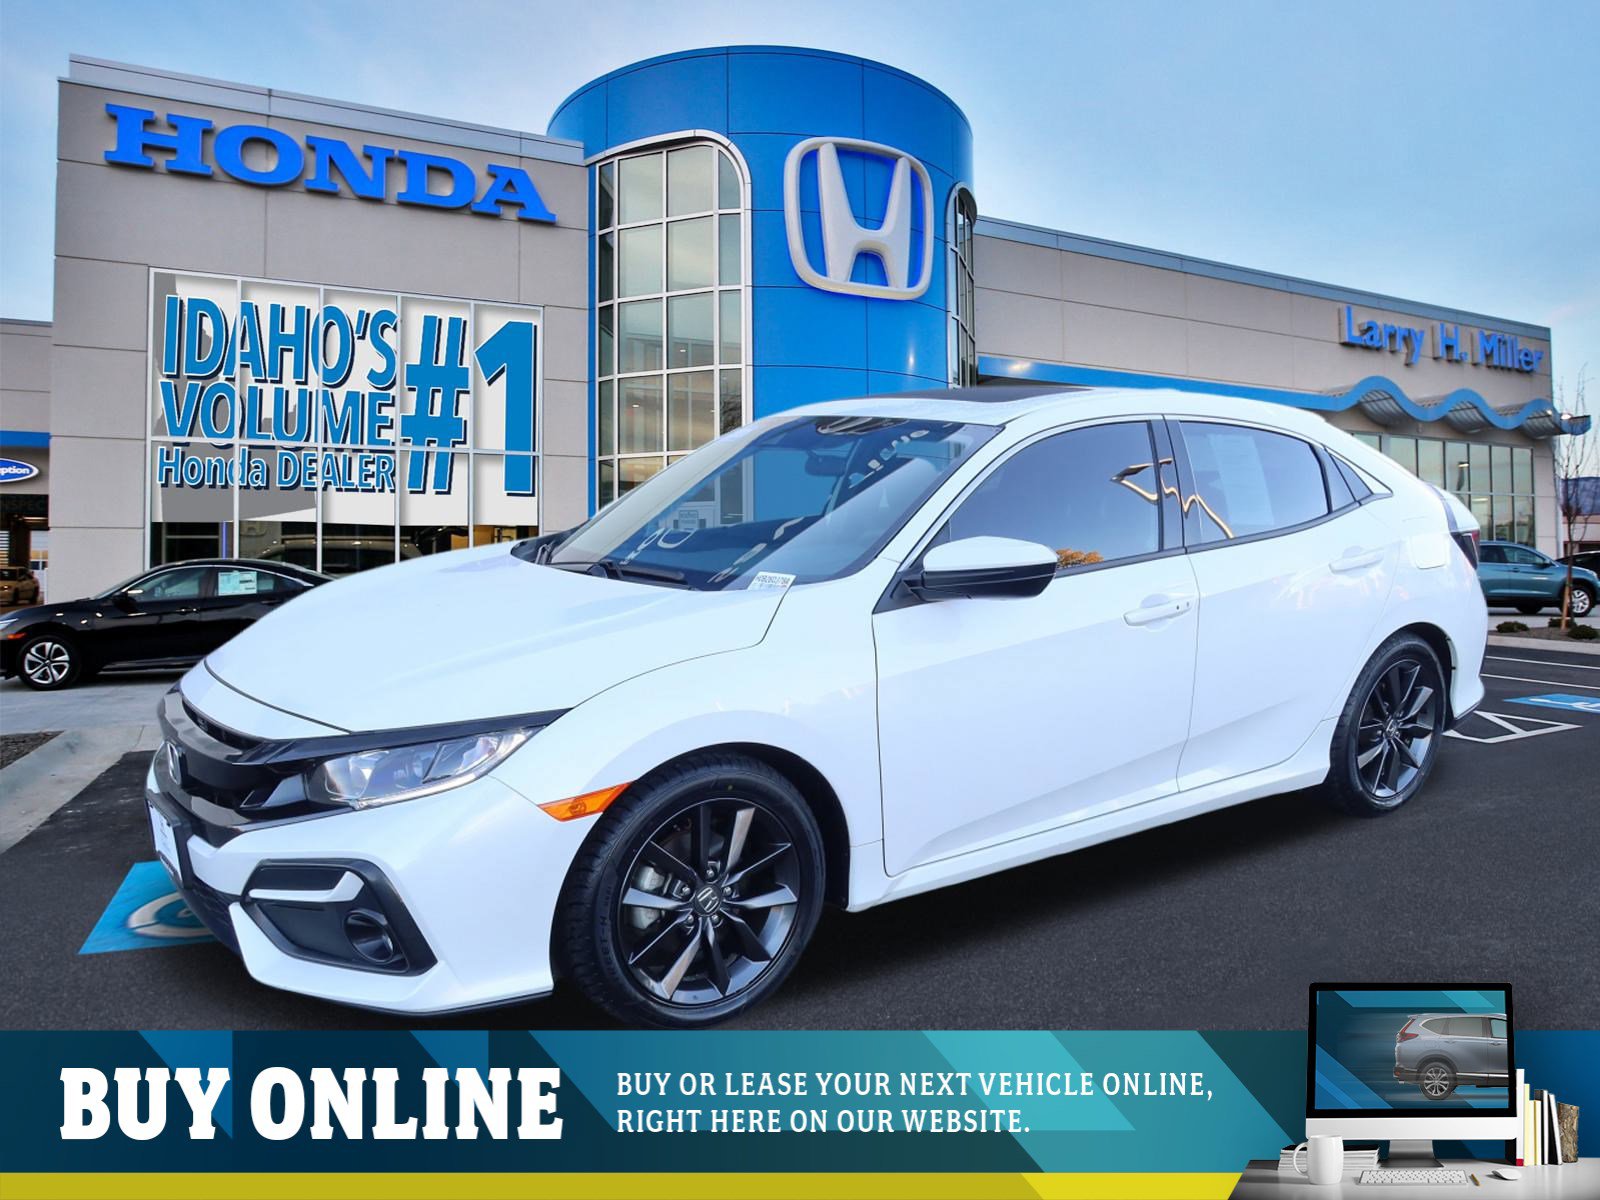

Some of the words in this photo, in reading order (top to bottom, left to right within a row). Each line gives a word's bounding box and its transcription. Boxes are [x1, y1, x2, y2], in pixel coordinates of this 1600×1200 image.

[104, 103, 557, 224] HONDA
[162, 294, 397, 390] IDAHO'S
[1341, 305, 1425, 367] Larry
[1436, 322, 1469, 363] H.
[1477, 329, 1545, 373] Miller
[159, 380, 396, 450] VOLUME
[399, 314, 537, 496] #1
[0, 465, 30, 477] ption
[157, 446, 268, 490] Honda
[276, 451, 396, 493] DEALER
